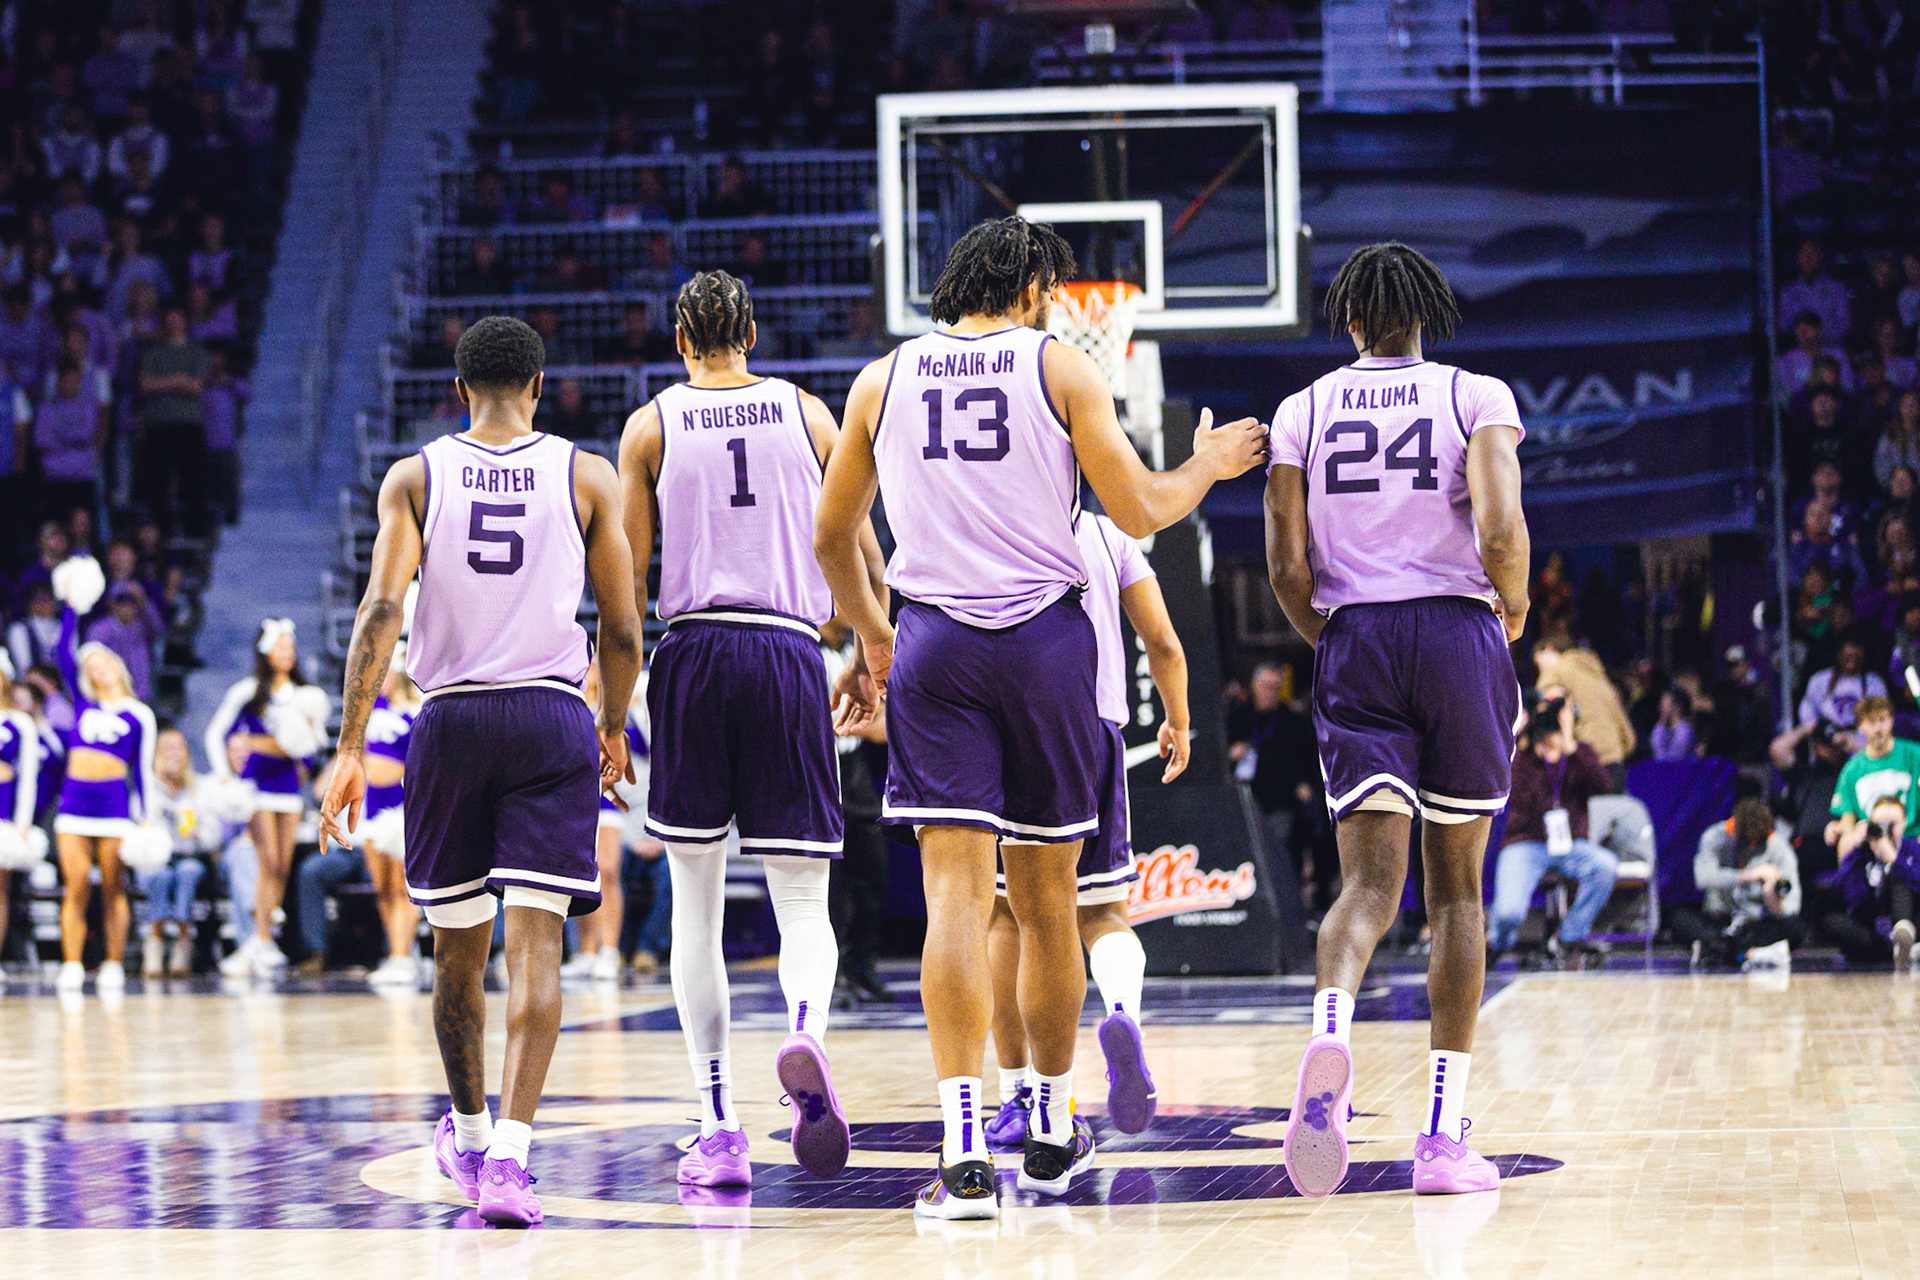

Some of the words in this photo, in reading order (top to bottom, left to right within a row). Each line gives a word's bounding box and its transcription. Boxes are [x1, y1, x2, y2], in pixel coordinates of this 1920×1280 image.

[917, 352, 985, 377] McNAIR
[992, 350, 1015, 374] JR
[682, 401, 783, 431] N'GUESSAN
[1342, 382, 1419, 410] KALUMA
[1511, 367, 1693, 417] VAN
[922, 387, 1010, 461] 13
[462, 466, 535, 492] CARTER
[726, 438, 756, 507] 1
[1325, 418, 1438, 495] 24
[467, 501, 526, 575] 5
[1128, 844, 1257, 904] illons
